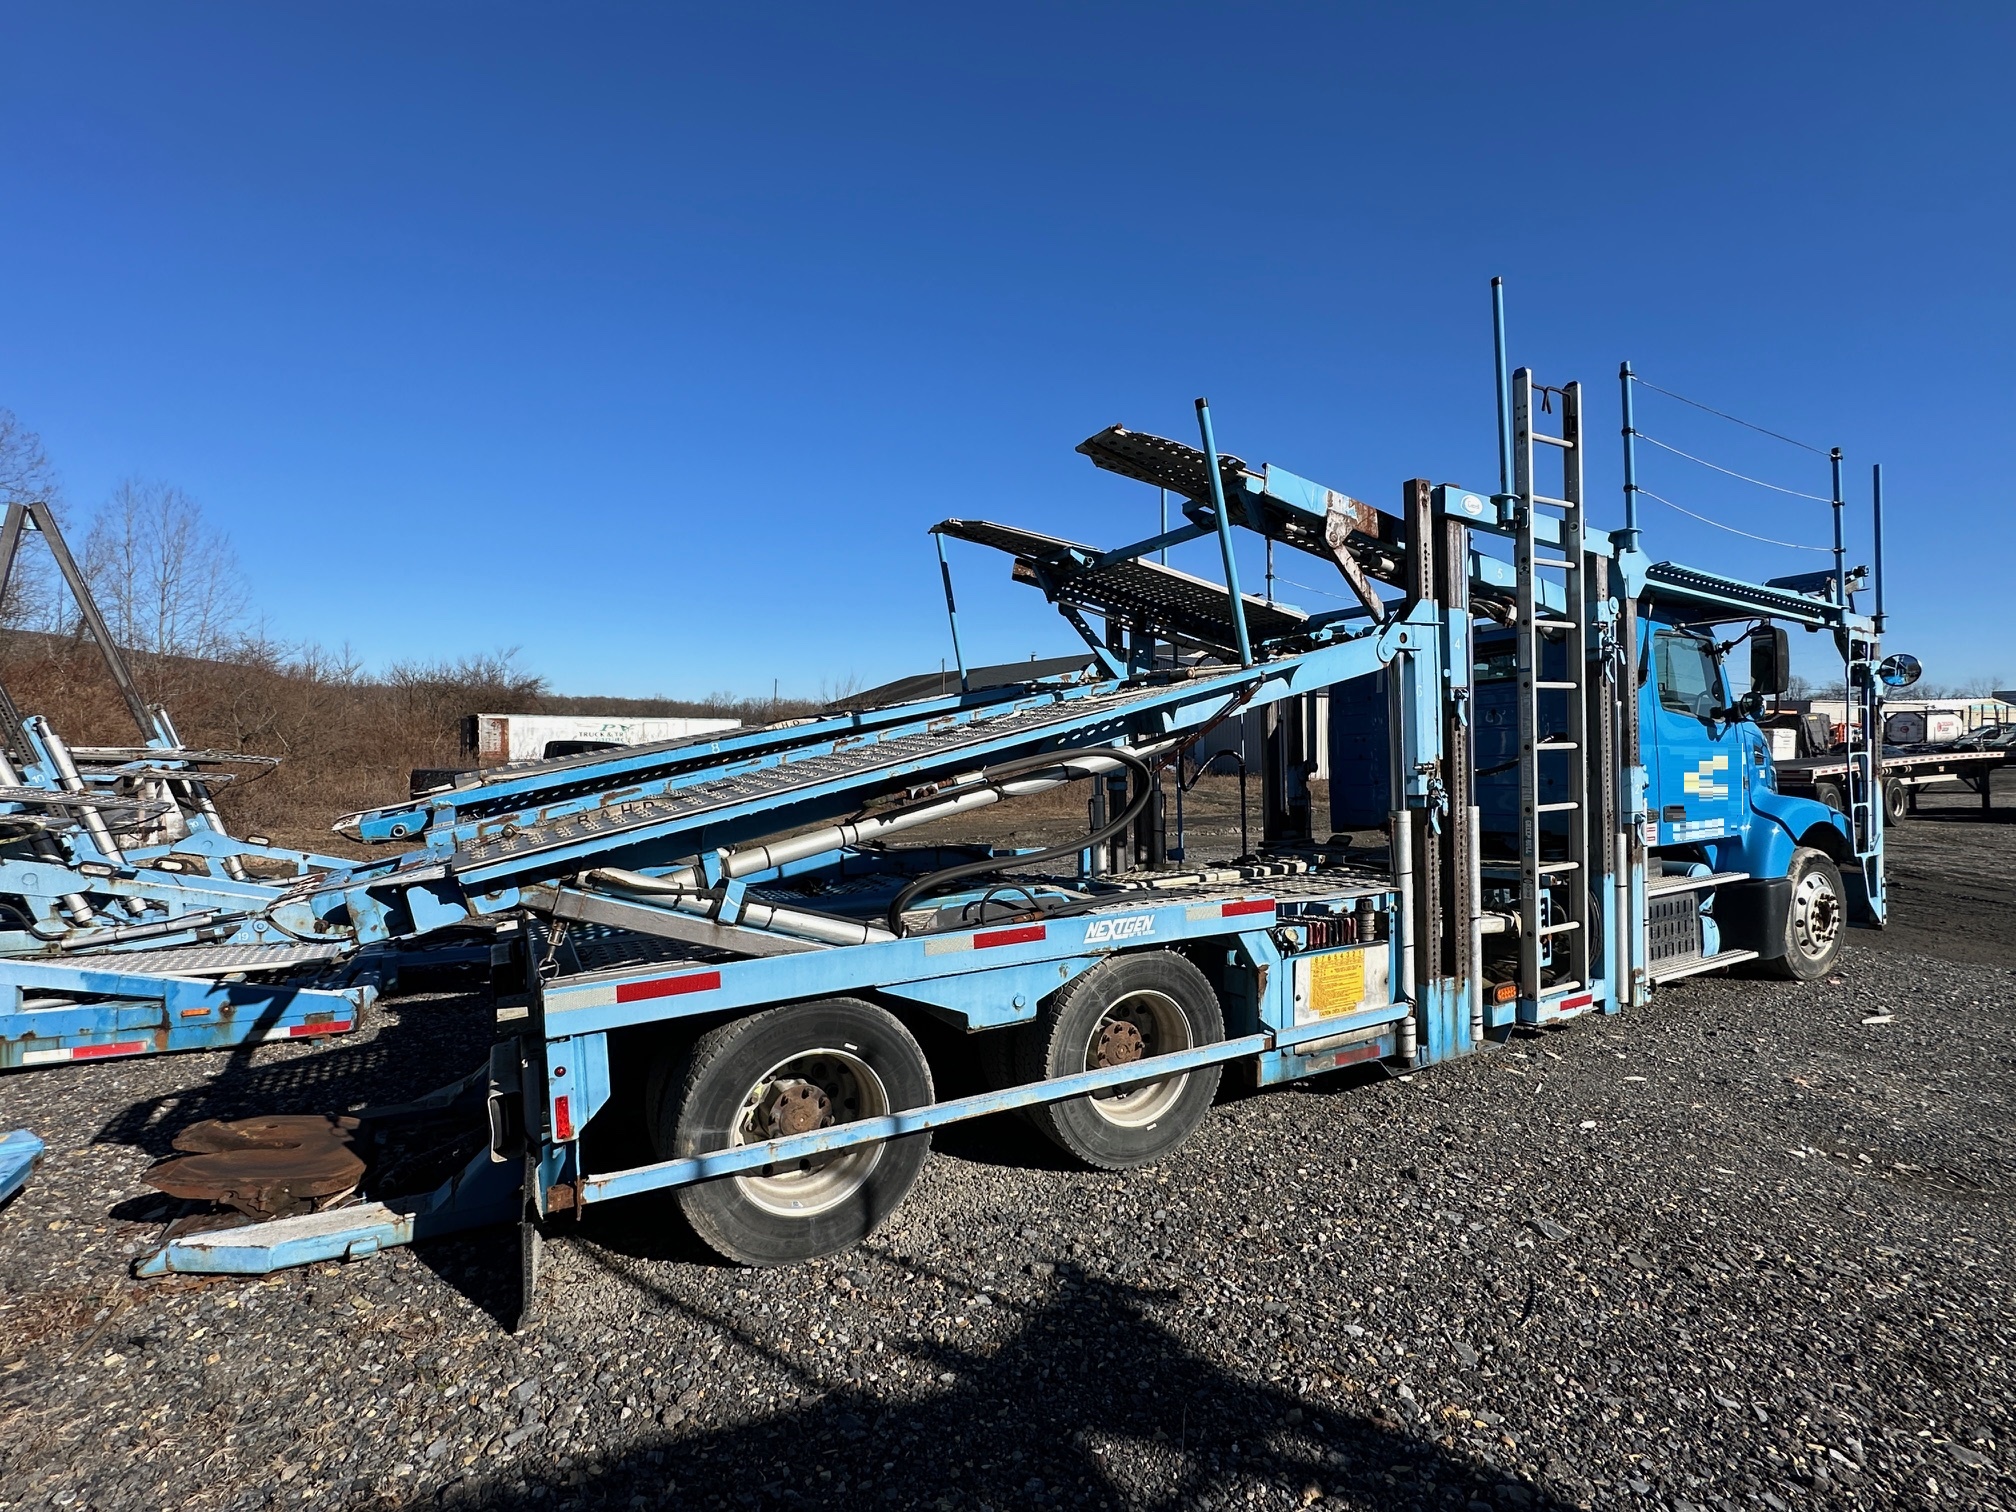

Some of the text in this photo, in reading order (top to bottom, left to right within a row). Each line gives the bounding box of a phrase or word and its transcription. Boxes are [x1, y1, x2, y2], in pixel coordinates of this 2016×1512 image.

[1497, 567, 1504, 580] 5
[1454, 637, 1461, 650] 4
[1416, 684, 1423, 698] 6
[711, 742, 720, 755] 8
[31, 774, 46, 784] 10
[1083, 914, 1156, 944] NEXTGEN
[237, 932, 249, 941] 19
